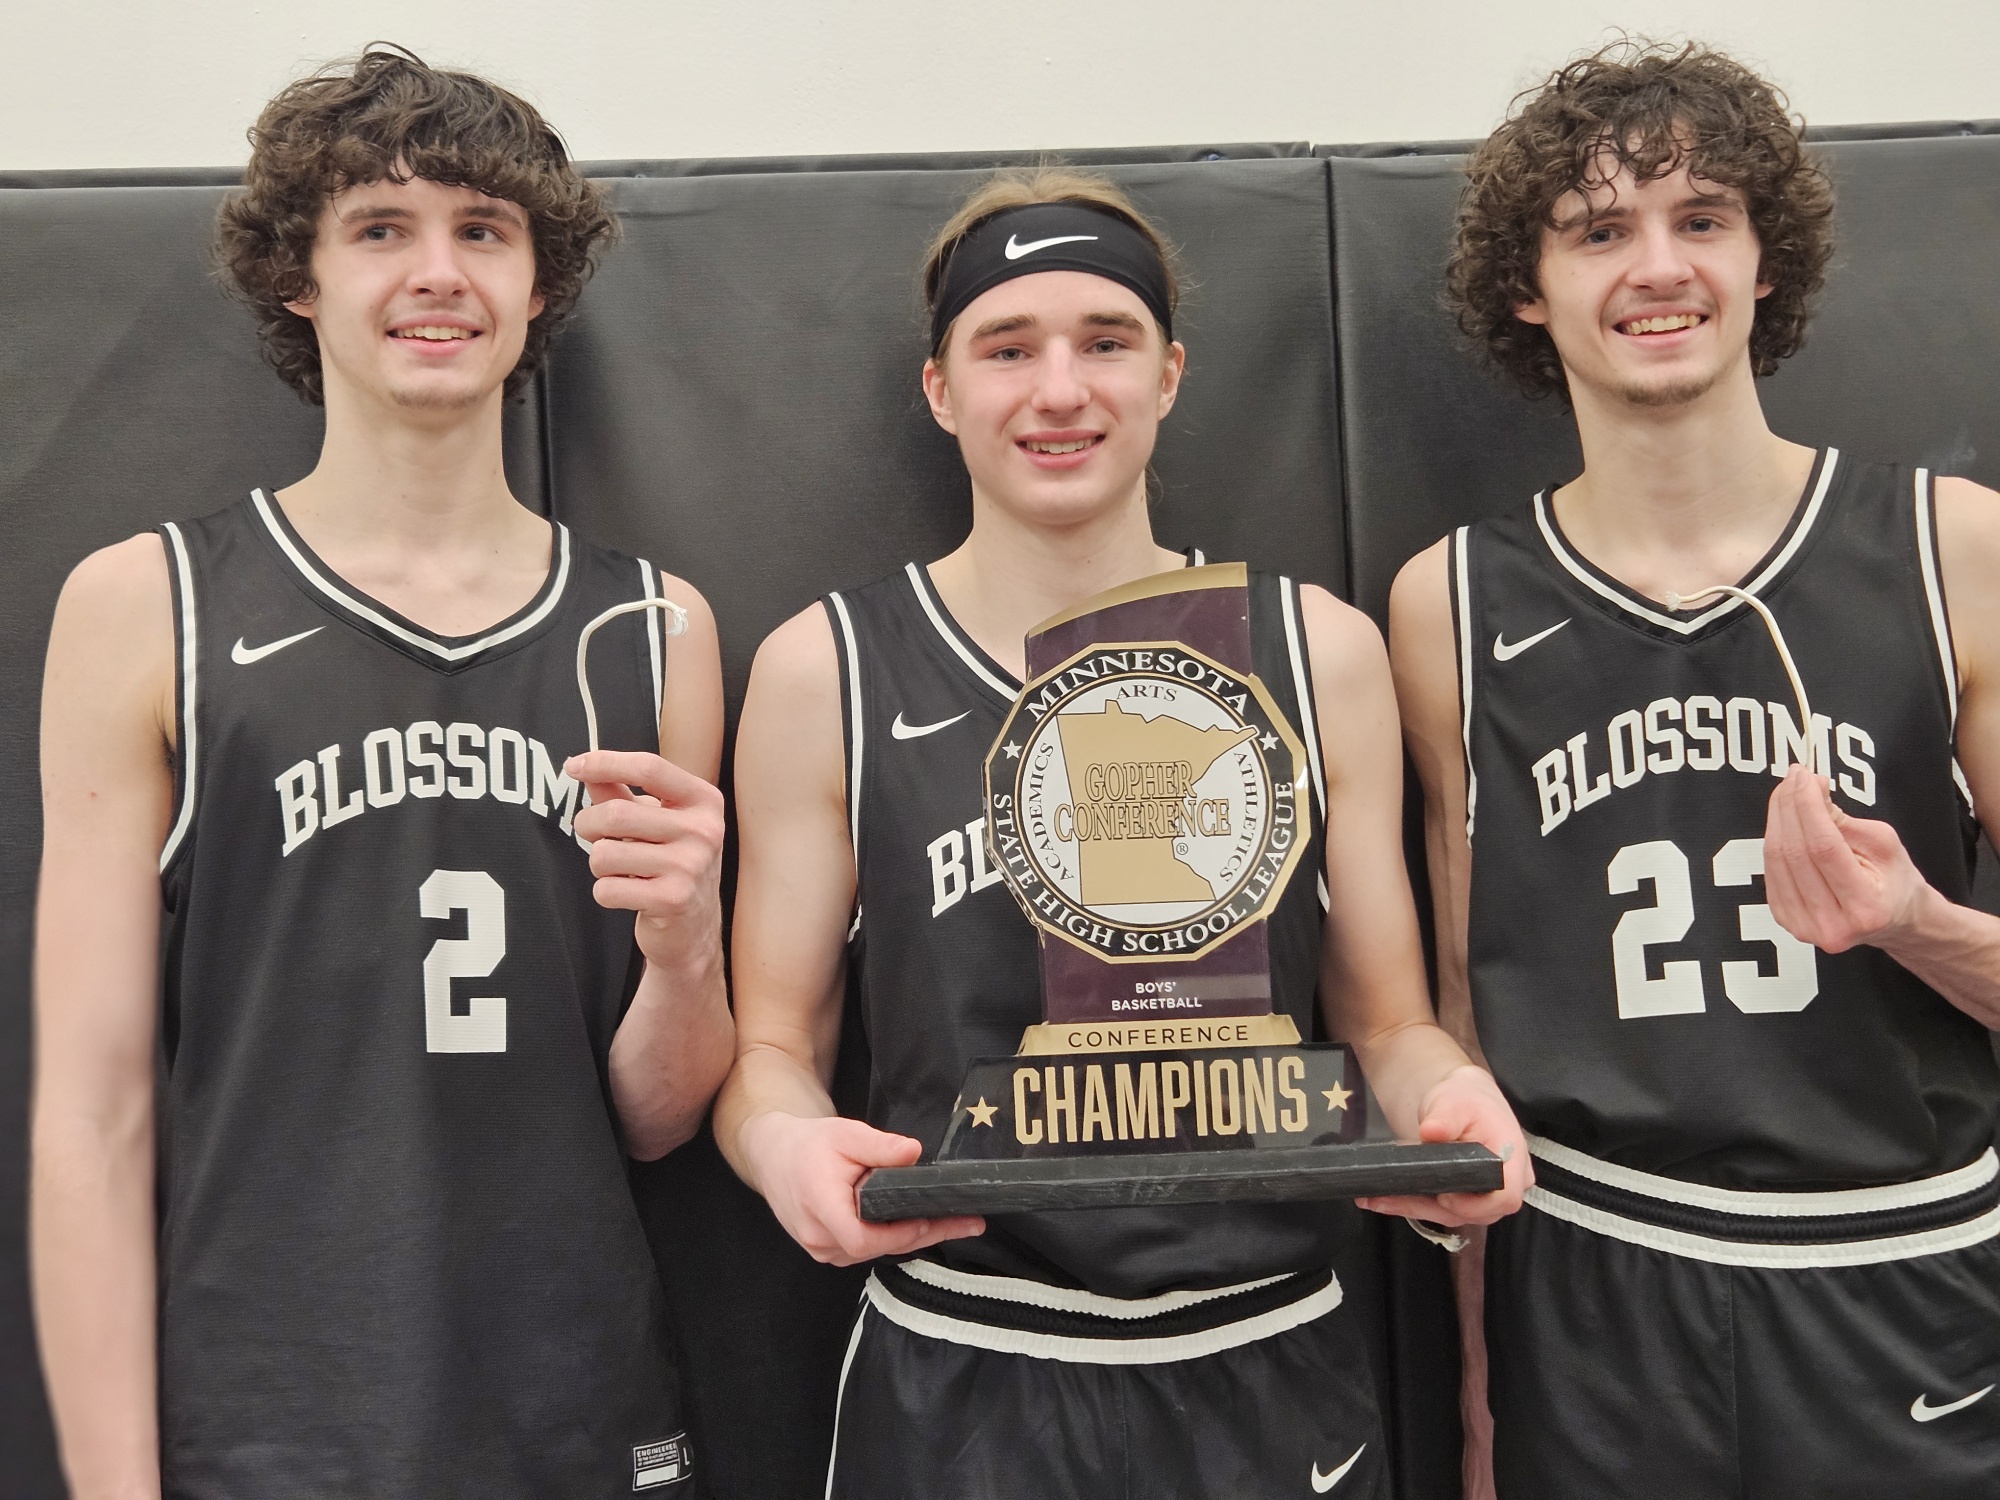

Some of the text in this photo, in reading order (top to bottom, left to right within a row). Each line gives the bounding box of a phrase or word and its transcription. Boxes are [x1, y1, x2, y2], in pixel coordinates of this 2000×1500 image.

[1024, 650, 1248, 722] MINNESOTA
[1115, 684, 1178, 703] ARTS
[274, 720, 593, 857] BLOSSOM
[1029, 742, 1074, 883] ACADEMICS
[1053, 798, 1232, 843] CONFERENCE
[1084, 760, 1197, 802] GOPHER
[1219, 751, 1258, 883] ATHLETICS
[1531, 695, 1877, 837] BLOSSOMS
[993, 793, 1039, 890] STATE
[1032, 887, 1112, 948] HIGH
[1121, 903, 1247, 953] SCHOOL
[1252, 781, 1294, 905] LEAGUE
[419, 869, 507, 1053] 2
[1607, 838, 1819, 1019] 23
[1068, 1024, 1249, 1049] CONFERENCE
[1111, 997, 1203, 1011] BASKETBALL
[1012, 1055, 1309, 1145] CHAMPIONS
